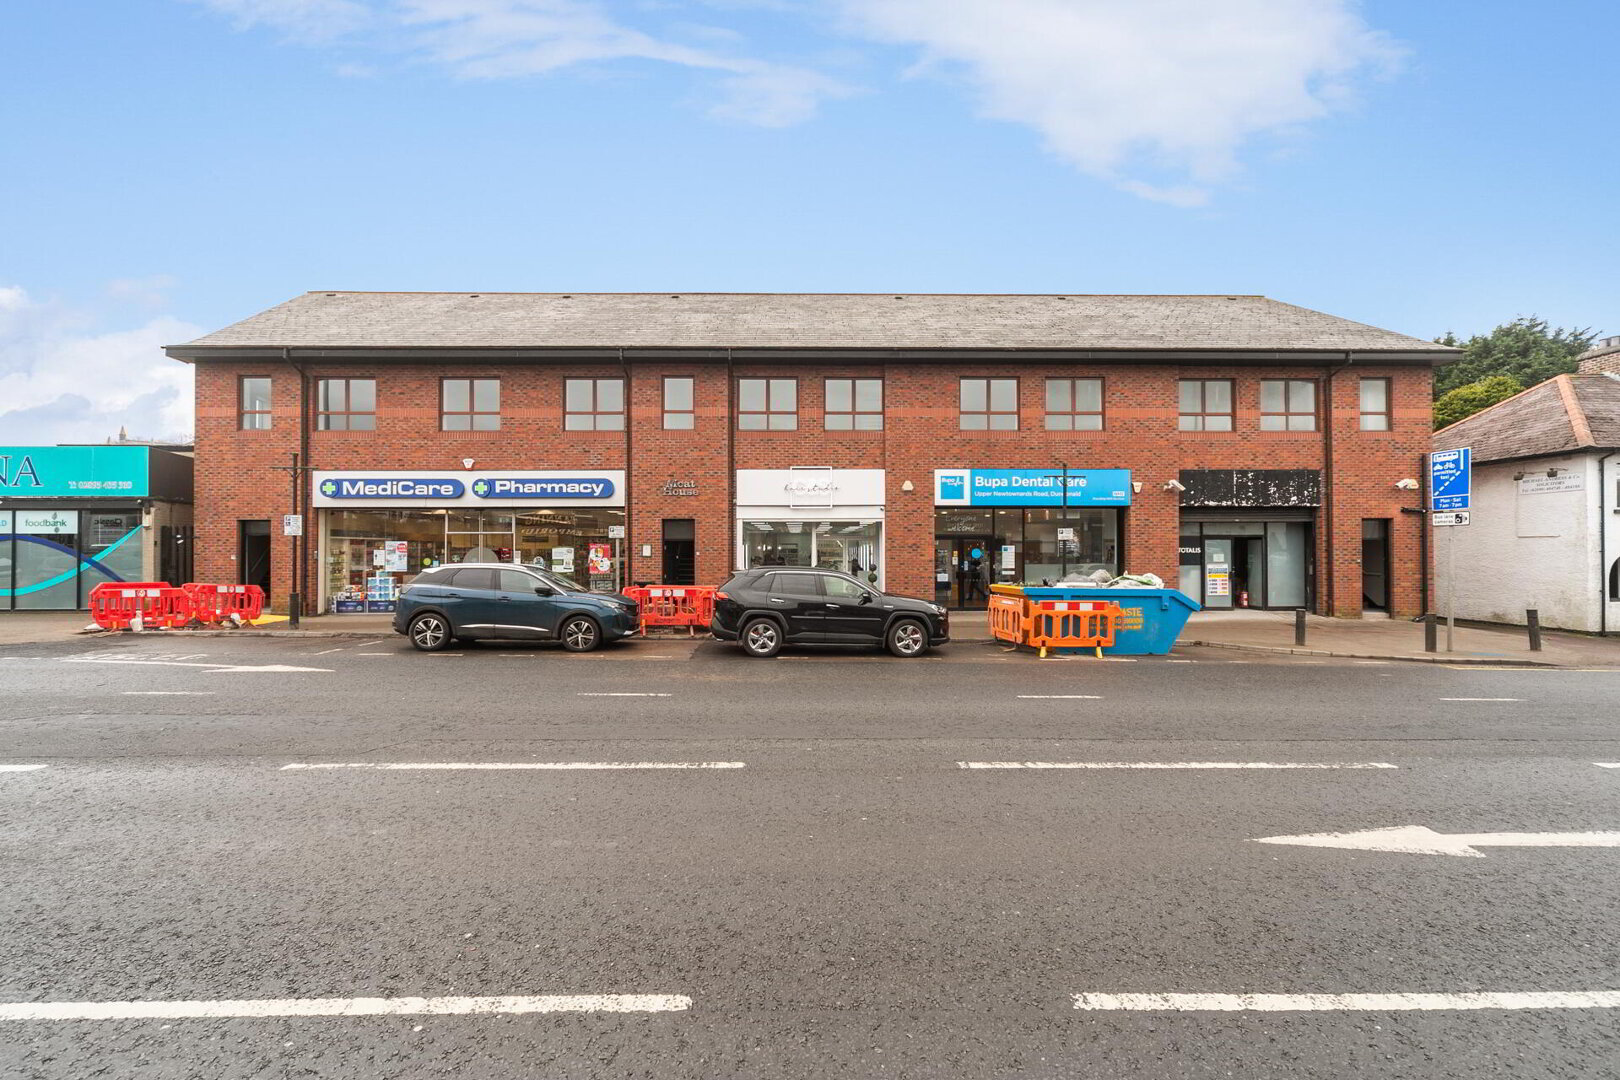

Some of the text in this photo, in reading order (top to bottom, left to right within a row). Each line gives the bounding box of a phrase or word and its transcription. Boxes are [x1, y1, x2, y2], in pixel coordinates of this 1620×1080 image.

[343, 481, 453, 495] MediCare
[975, 476, 1008, 488] Bupa
[1012, 476, 1053, 487] Dental
[495, 481, 604, 496] Pharmacy
[662, 487, 699, 496] House
[25, 519, 67, 527] foodbank
